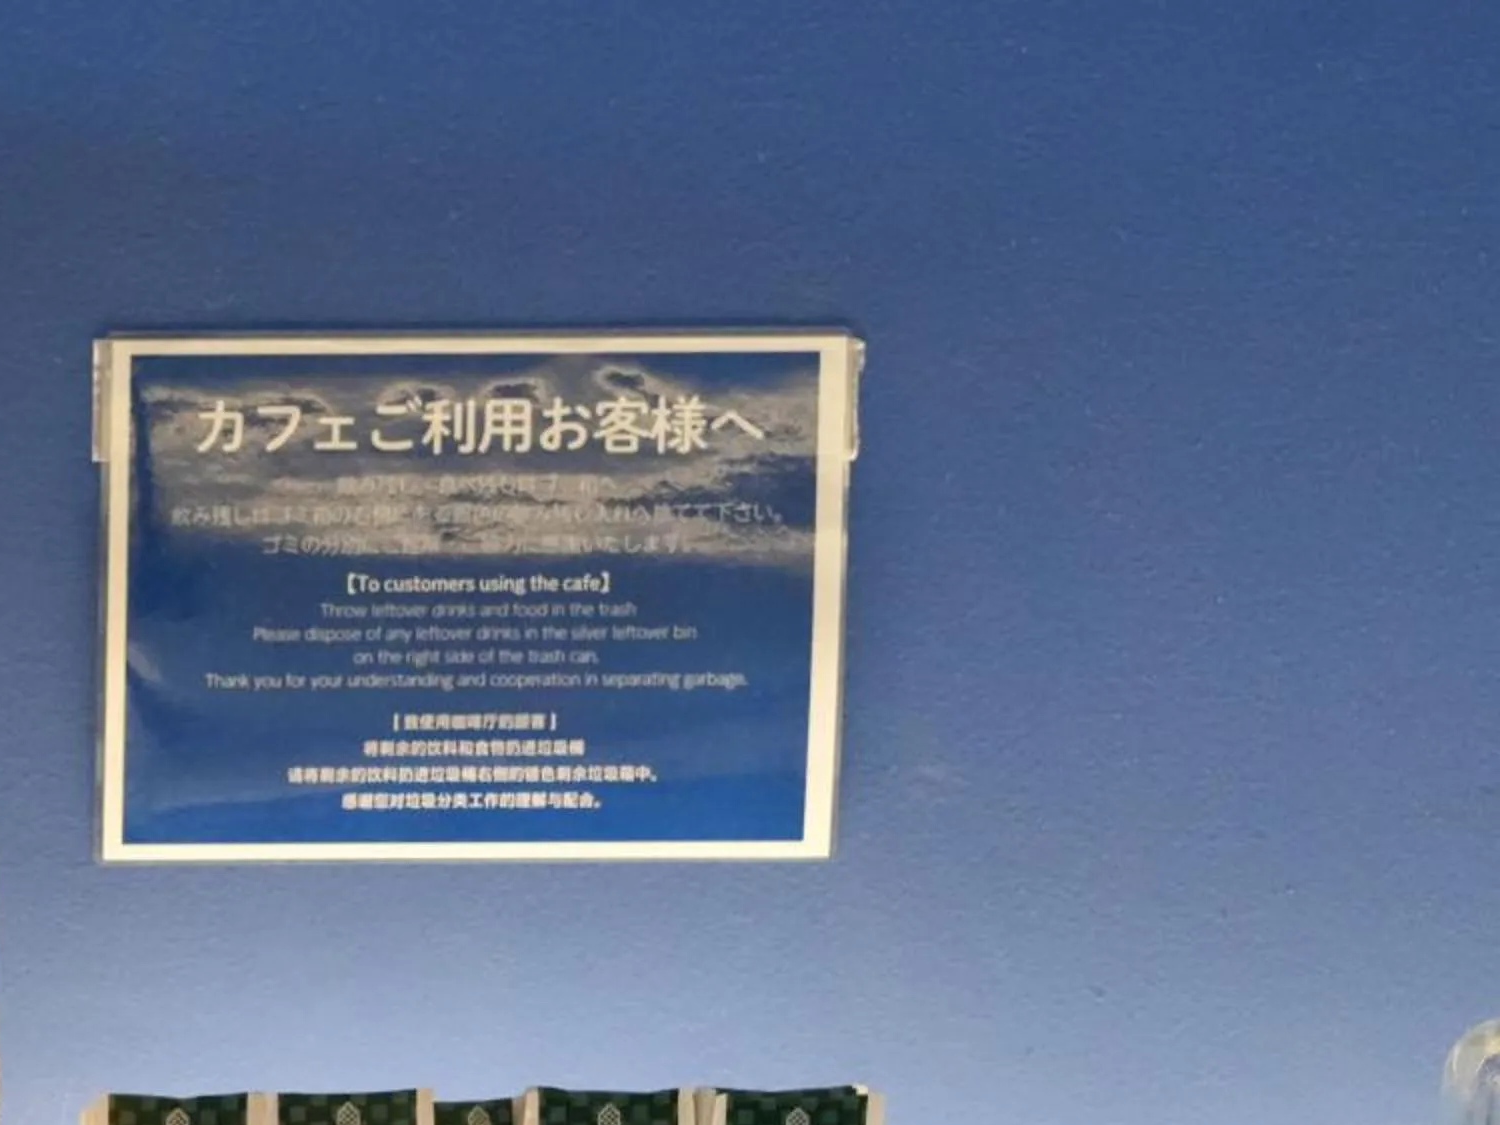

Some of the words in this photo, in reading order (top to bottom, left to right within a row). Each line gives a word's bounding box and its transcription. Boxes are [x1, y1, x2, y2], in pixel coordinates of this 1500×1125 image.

[197, 396, 765, 456] カフェご利用お客様へ
[384, 576, 475, 593] customers
[479, 575, 526, 595] using
[529, 575, 560, 592] the
[320, 602, 368, 618] Throw
[371, 602, 428, 618] leftover
[431, 602, 476, 618] drinks
[480, 602, 509, 617] and
[512, 602, 548, 617] food
[551, 602, 565, 617] in
[569, 602, 595, 617] the
[599, 602, 638, 617] trash
[253, 626, 301, 642] Please
[305, 626, 362, 645] dispose
[366, 626, 382, 641] of
[385, 628, 411, 645] any
[416, 626, 472, 641] leftover
[476, 626, 520, 641] drinks
[524, 626, 539, 640] in
[542, 626, 569, 640] the
[572, 626, 608, 640] silver
[612, 625, 669, 640] leftover
[353, 652, 374, 665] on
[377, 649, 402, 665] the
[405, 649, 440, 668] right
[444, 649, 474, 665] side
[478, 649, 494, 665] of
[498, 649, 524, 665] the
[528, 649, 565, 664] trash
[205, 673, 248, 689] Thank
[253, 676, 282, 691] you
[285, 673, 307, 689] for
[310, 676, 344, 691] your
[347, 673, 454, 692] understanding
[457, 673, 485, 689] and
[489, 673, 581, 690] cooperation
[584, 673, 598, 688] in
[602, 673, 680, 691] separating
